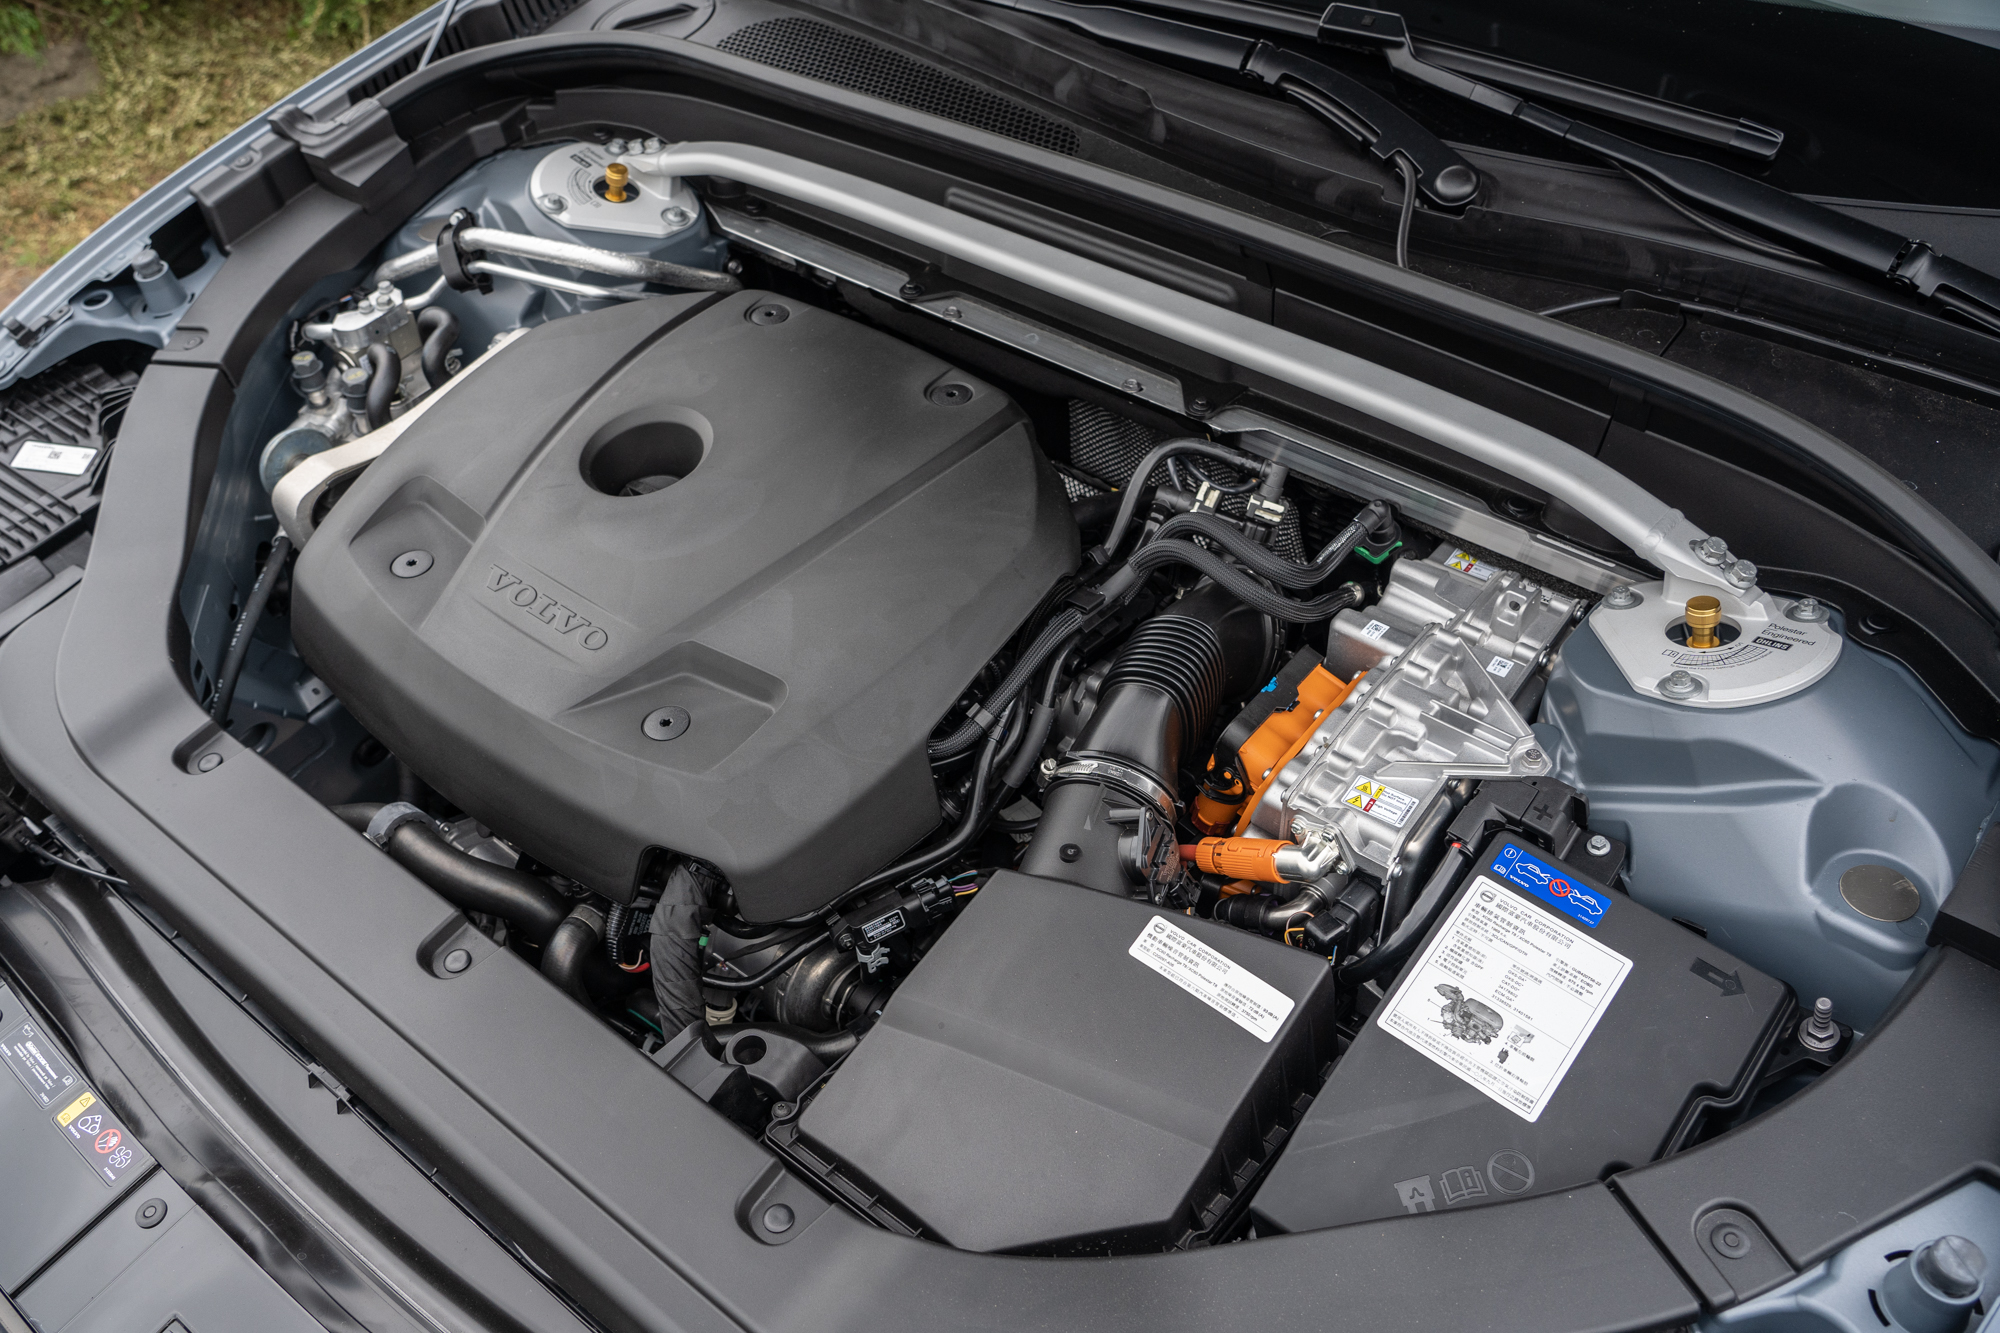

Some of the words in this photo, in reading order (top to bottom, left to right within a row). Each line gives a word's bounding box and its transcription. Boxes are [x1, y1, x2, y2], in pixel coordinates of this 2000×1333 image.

[487, 564, 608, 650] VOLVO
[1768, 623, 1807, 635] Polestar
[1761, 629, 1816, 646] Engineered
[1508, 874, 1530, 889] VOLVO
[1492, 920, 1511, 934] Recharge
[1499, 898, 1519, 912] VOLVO
[1519, 910, 1533, 920] CAR
[1534, 918, 1575, 944] CORPORATION
[1169, 929, 1186, 941] VOLVO
[1186, 940, 1197, 949] CAR
[1198, 947, 1232, 970] CORPORATION
[68, 1125, 80, 1139] VOLVO
